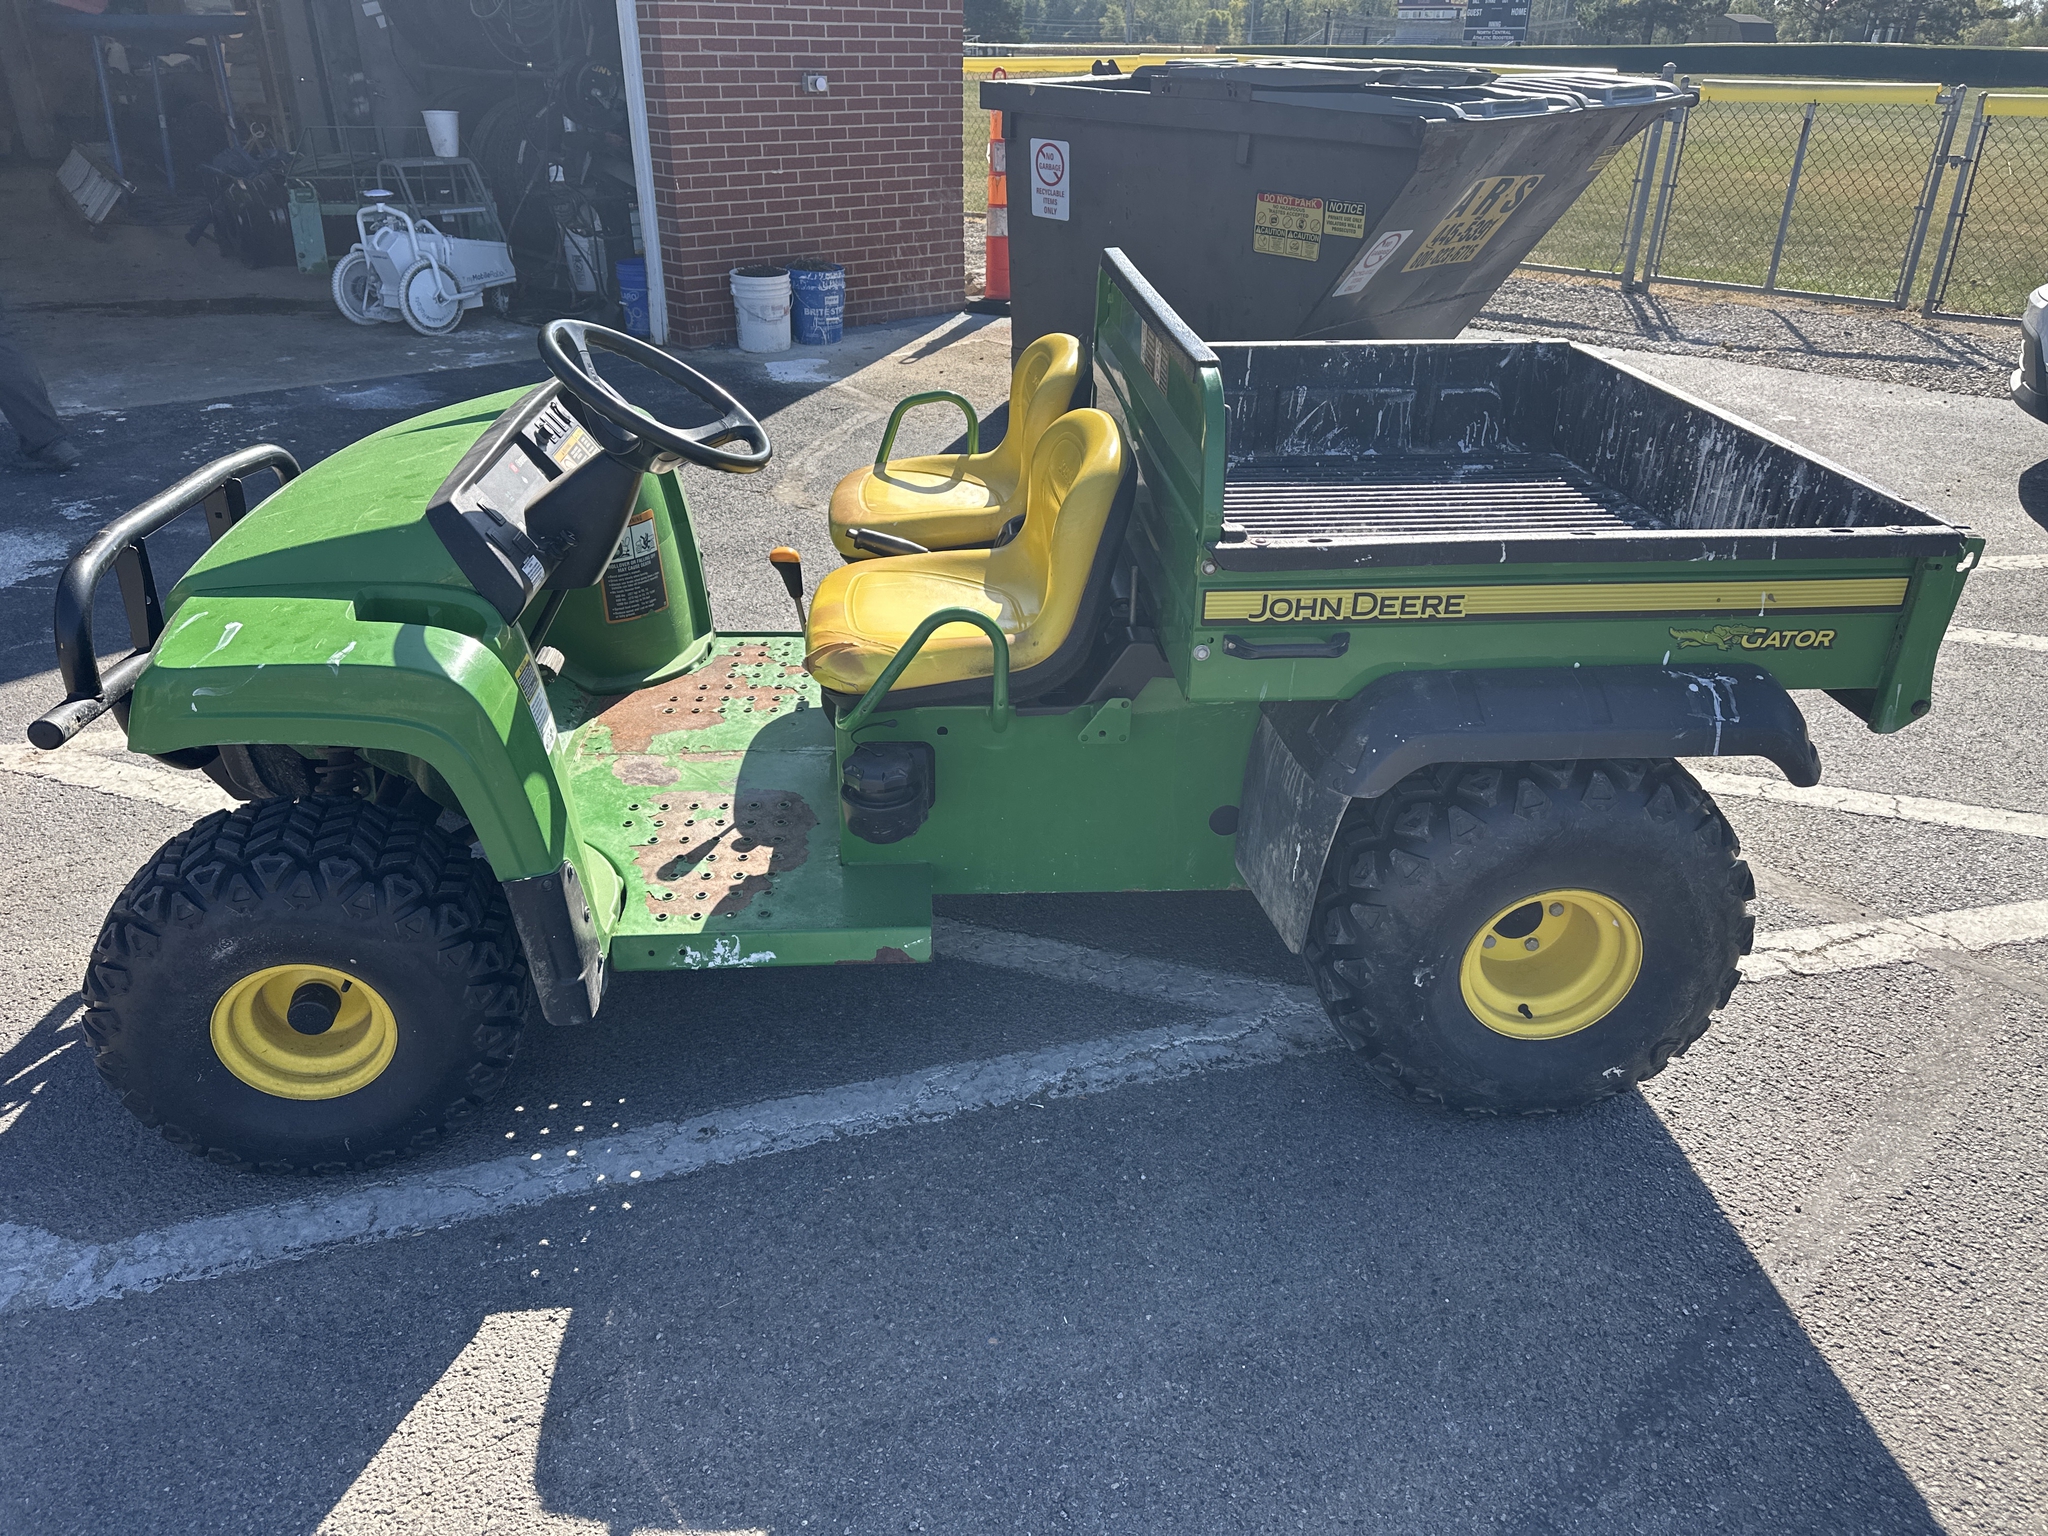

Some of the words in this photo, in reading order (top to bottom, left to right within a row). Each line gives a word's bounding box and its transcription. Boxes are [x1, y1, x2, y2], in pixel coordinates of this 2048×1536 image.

[1467, 8, 1482, 16] GUEST
[1511, 8, 1527, 16] HOME
[1045, 152, 1054, 160] NO
[1039, 162, 1061, 172] GARBAGE
[1036, 187, 1065, 198] RECYCLABLE
[1043, 197, 1057, 205] ITEMS
[1264, 194, 1275, 202] DO
[1276, 195, 1293, 205] NOT
[1295, 198, 1317, 208] PARK
[1044, 206, 1057, 215] ONLY
[1329, 202, 1364, 214] NOTICE
[1260, 226, 1286, 237] CAUTION
[1294, 231, 1319, 242] CAUTION
[1248, 594, 1343, 620] JOHN
[1351, 592, 1466, 617] DEERE
[1741, 628, 1835, 648] GATOR
